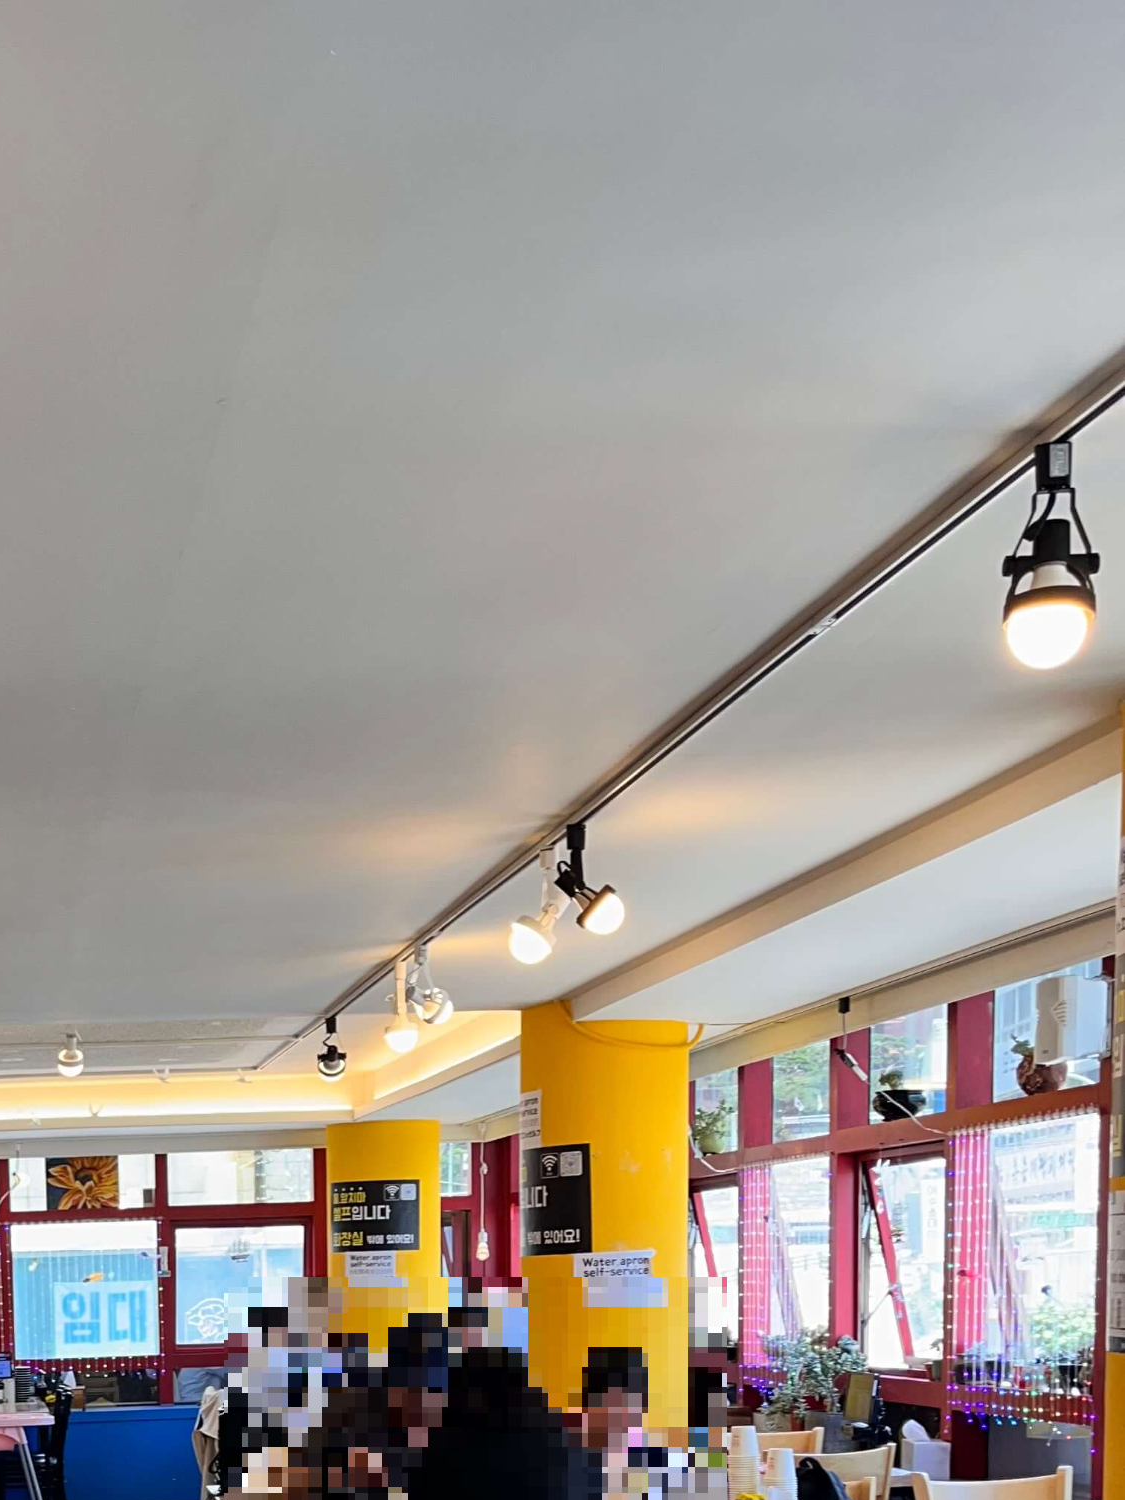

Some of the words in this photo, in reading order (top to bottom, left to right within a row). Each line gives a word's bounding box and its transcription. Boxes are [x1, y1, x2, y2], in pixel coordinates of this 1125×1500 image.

[543, 1229, 580, 1244] 있어요!
[620, 1257, 650, 1267] apron
[583, 1267, 650, 1278] self-service
[62, 1290, 147, 1344] 임대
